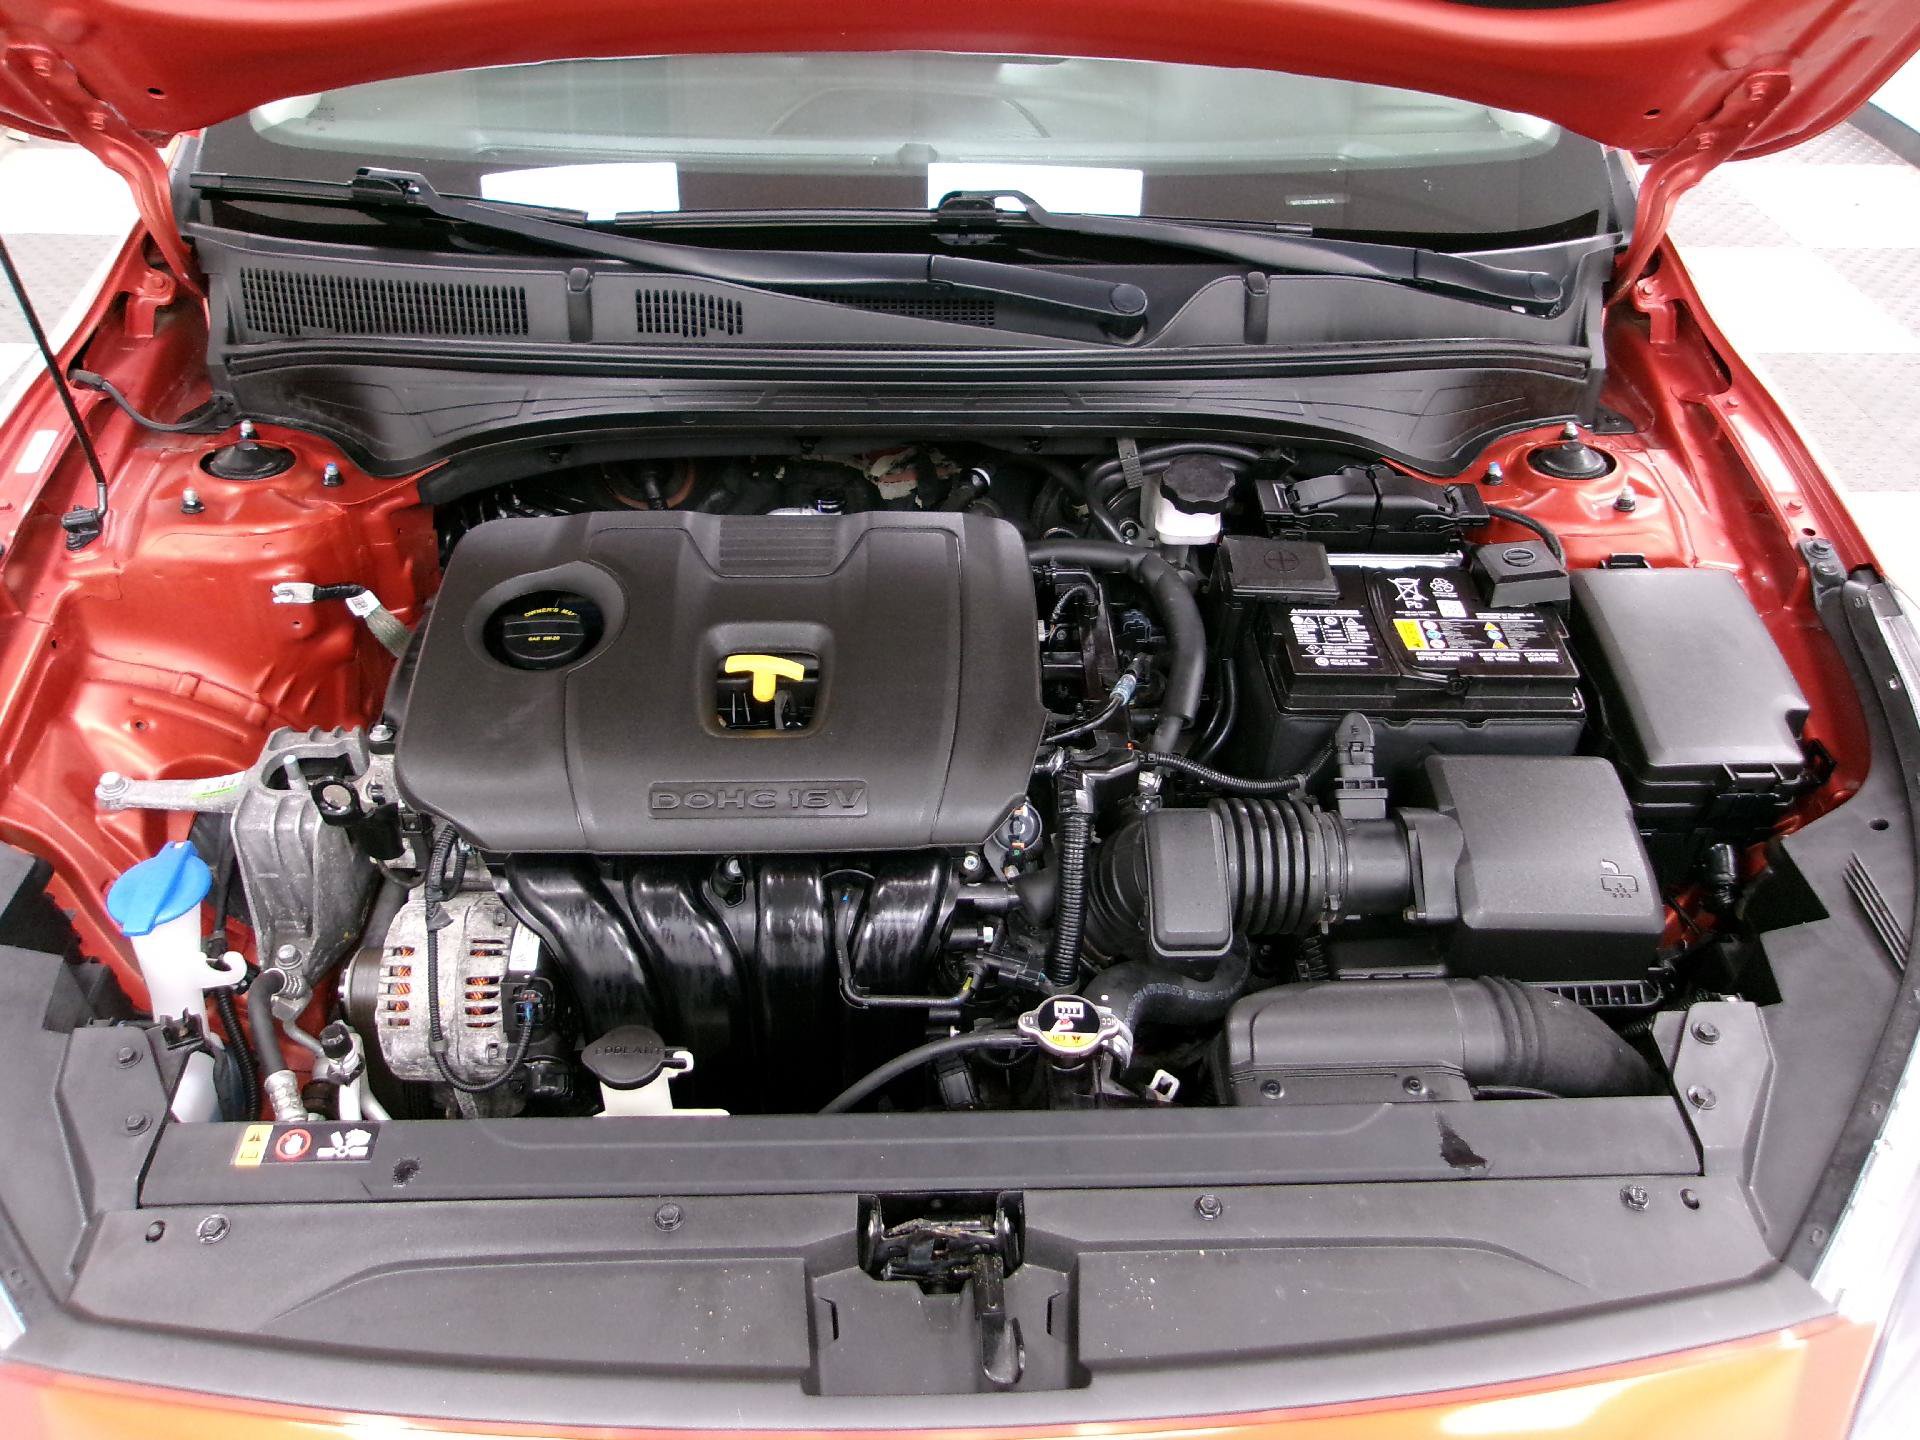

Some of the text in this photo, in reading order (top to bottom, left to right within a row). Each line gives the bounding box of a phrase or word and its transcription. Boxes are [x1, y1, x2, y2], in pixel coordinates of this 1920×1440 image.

[1404, 600, 1423, 609] Pb
[524, 607, 559, 617] OWNER'S
[651, 788, 865, 809] DOHC 16V
